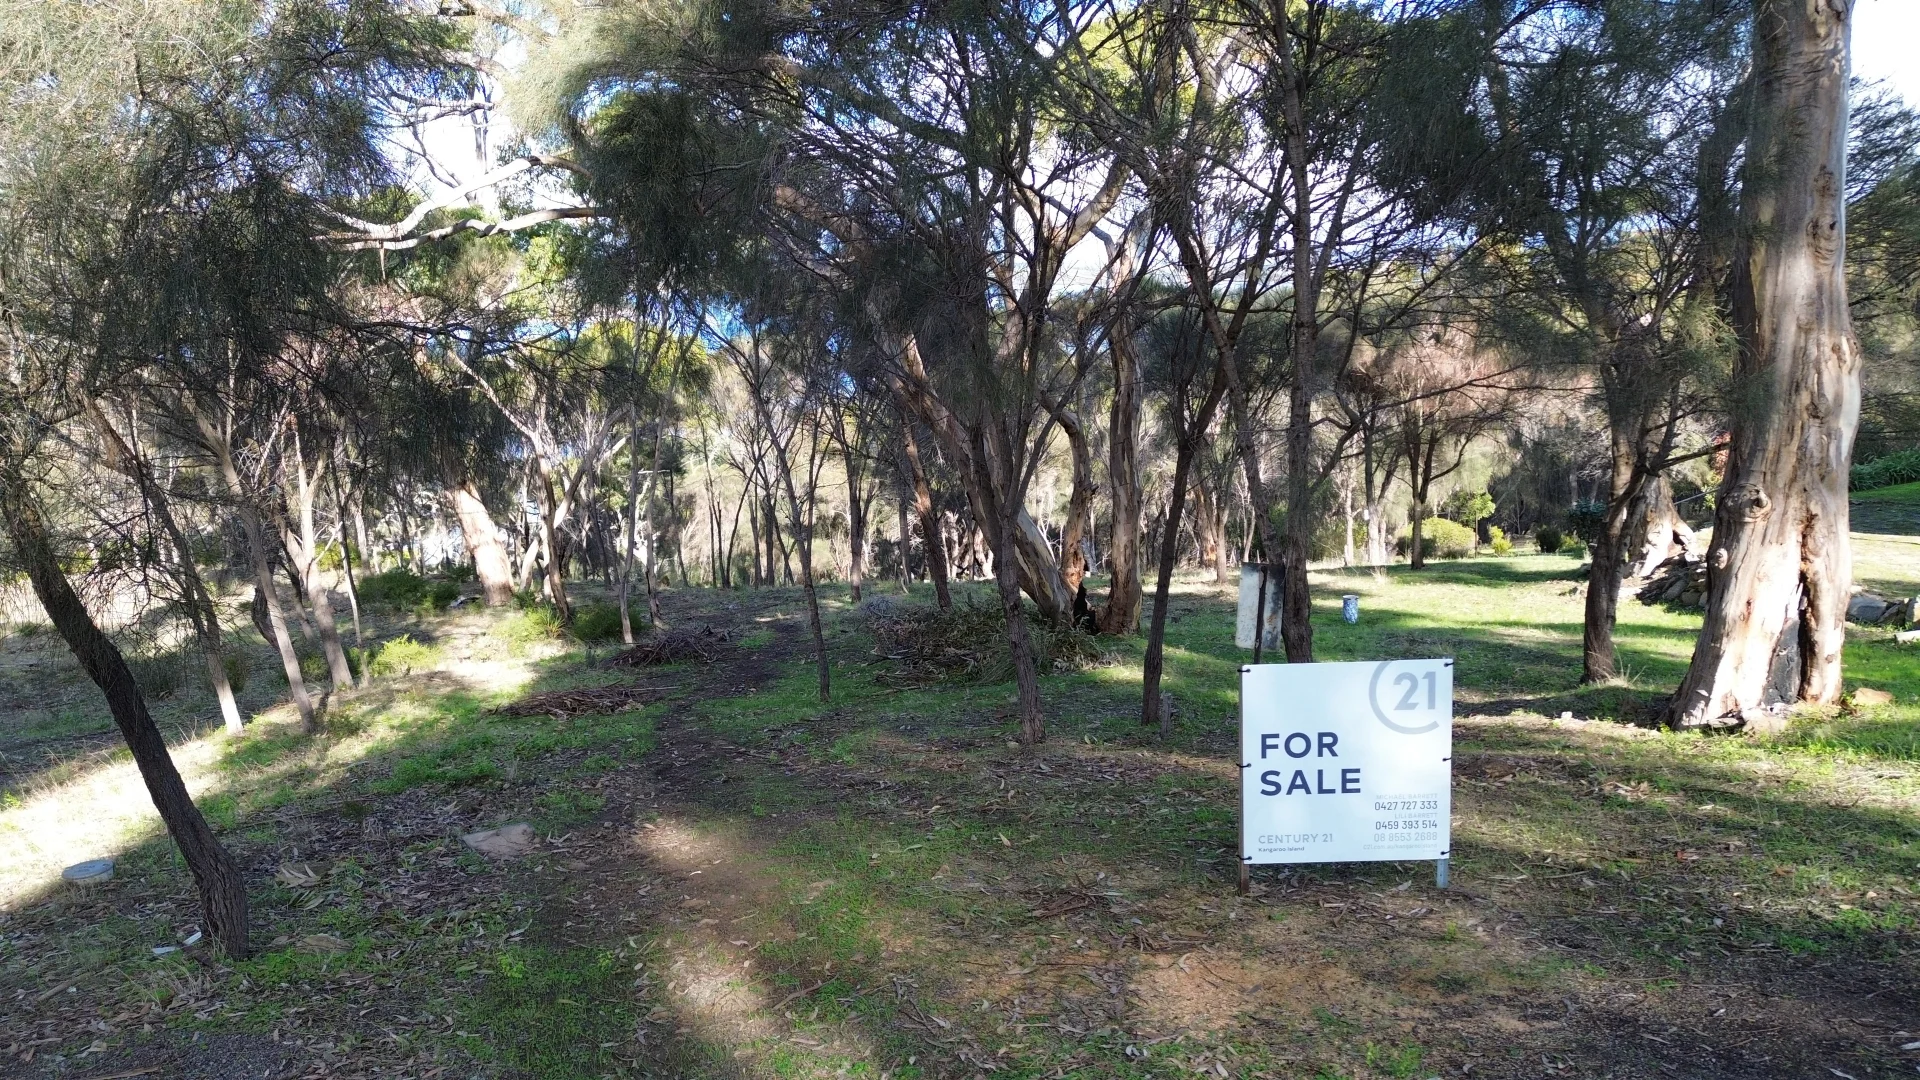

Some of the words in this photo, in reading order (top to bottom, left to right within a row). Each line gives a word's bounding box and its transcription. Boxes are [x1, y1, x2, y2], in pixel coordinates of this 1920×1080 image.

[1261, 732, 1339, 759] FOR
[1260, 768, 1361, 796] SALE
[1374, 801, 1398, 811] 0427
[1400, 801, 1417, 810] 727
[1419, 800, 1438, 810] 333
[1375, 820, 1399, 830] 0459
[1401, 820, 1419, 830] 393
[1422, 819, 1438, 829] 514
[1258, 833, 1319, 844] CENTURY
[1322, 833, 1333, 843] 21
[1373, 833, 1386, 842] 08
[1388, 832, 1412, 842] 8553
[1414, 831, 1438, 841] 2688
